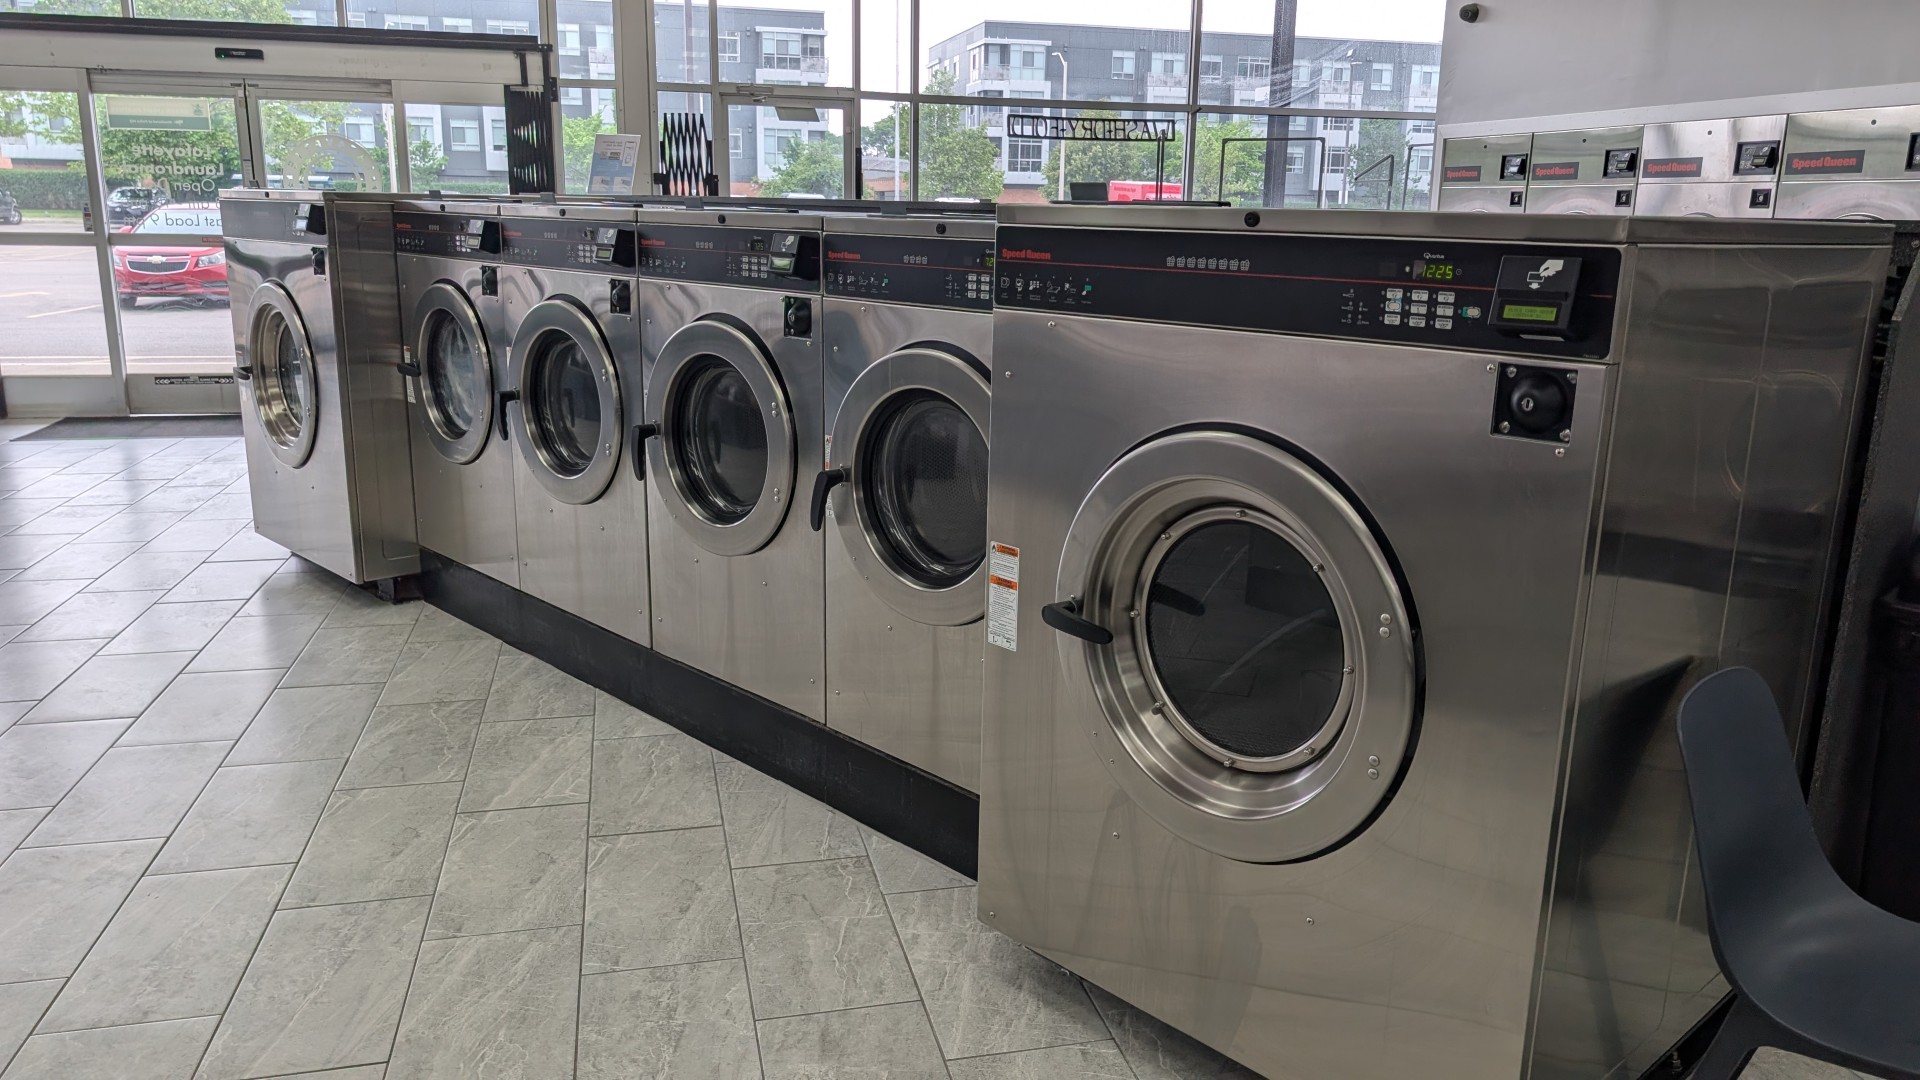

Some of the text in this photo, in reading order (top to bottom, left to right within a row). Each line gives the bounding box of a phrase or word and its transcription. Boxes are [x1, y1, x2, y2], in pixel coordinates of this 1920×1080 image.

[1647, 162, 1696, 174] Speed Queen
[1792, 156, 1856, 169] Speed Queen
[1447, 170, 1461, 178] Speed
[1535, 167, 1574, 176] Speed Queen
[1002, 248, 1025, 260] Speed
[1026, 249, 1051, 260] Queen
